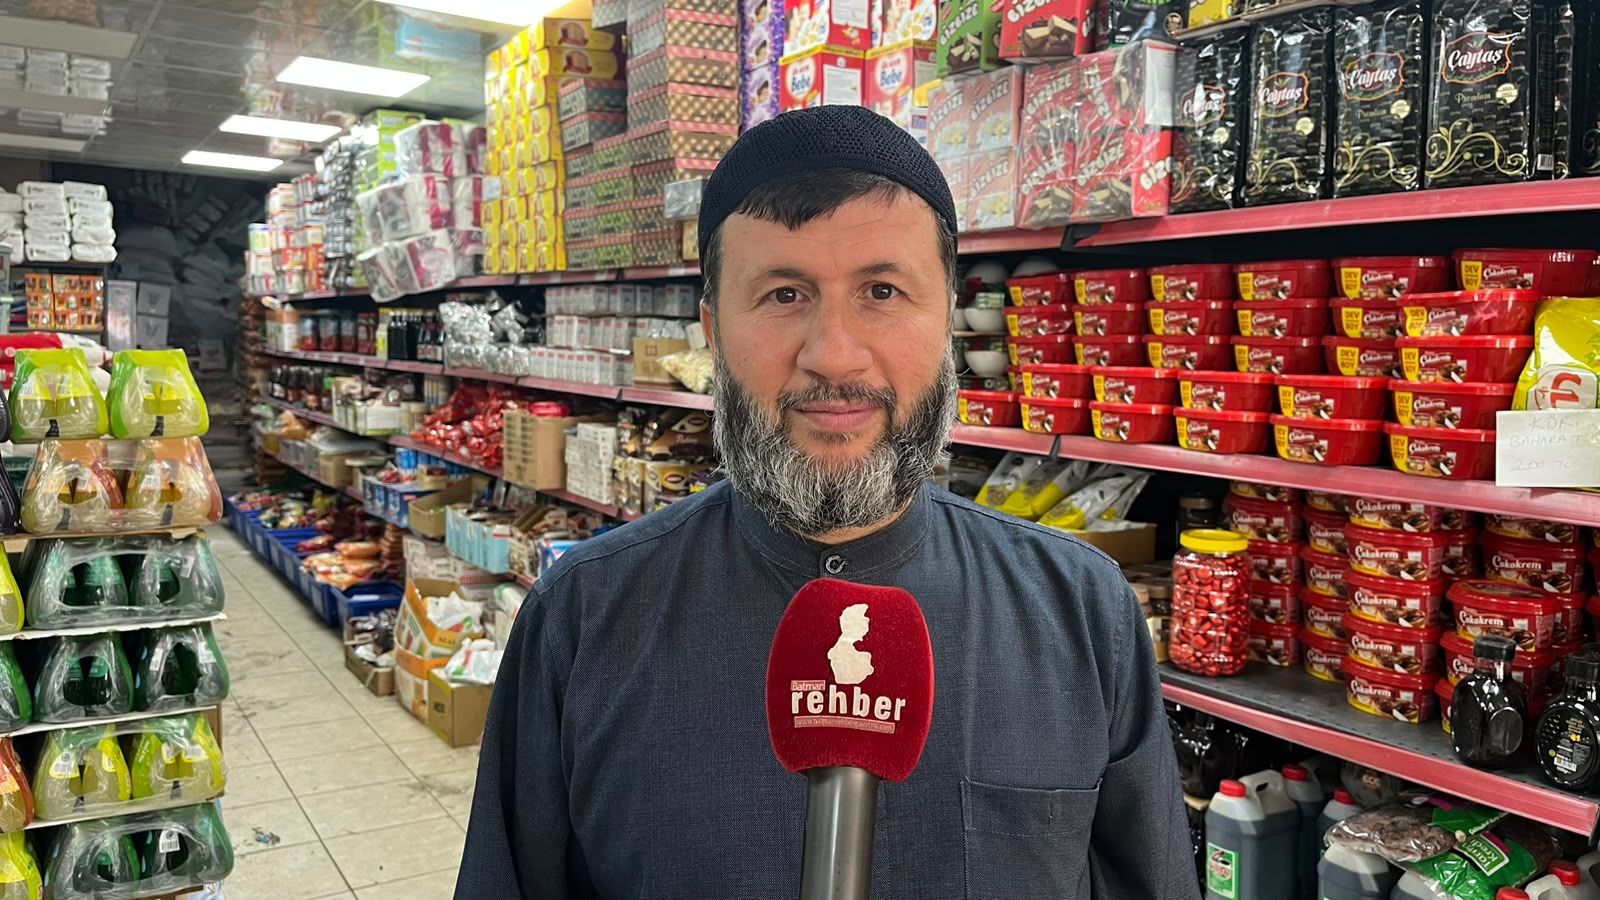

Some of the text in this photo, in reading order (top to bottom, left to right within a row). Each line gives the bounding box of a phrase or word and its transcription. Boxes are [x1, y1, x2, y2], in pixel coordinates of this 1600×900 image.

[1448, 48, 1504, 71] Çaytaş
[1356, 499, 1401, 514] Çokokrem
[1355, 545, 1399, 562] Çokokrem
[1492, 554, 1542, 570] Çokokrem
[1354, 591, 1397, 608] Çokokrem
[1459, 610, 1504, 627] Çokokrem
[1352, 637, 1393, 652] Çokokrem
[1350, 679, 1391, 698] Çokokrem
[792, 684, 906, 721] rehber
